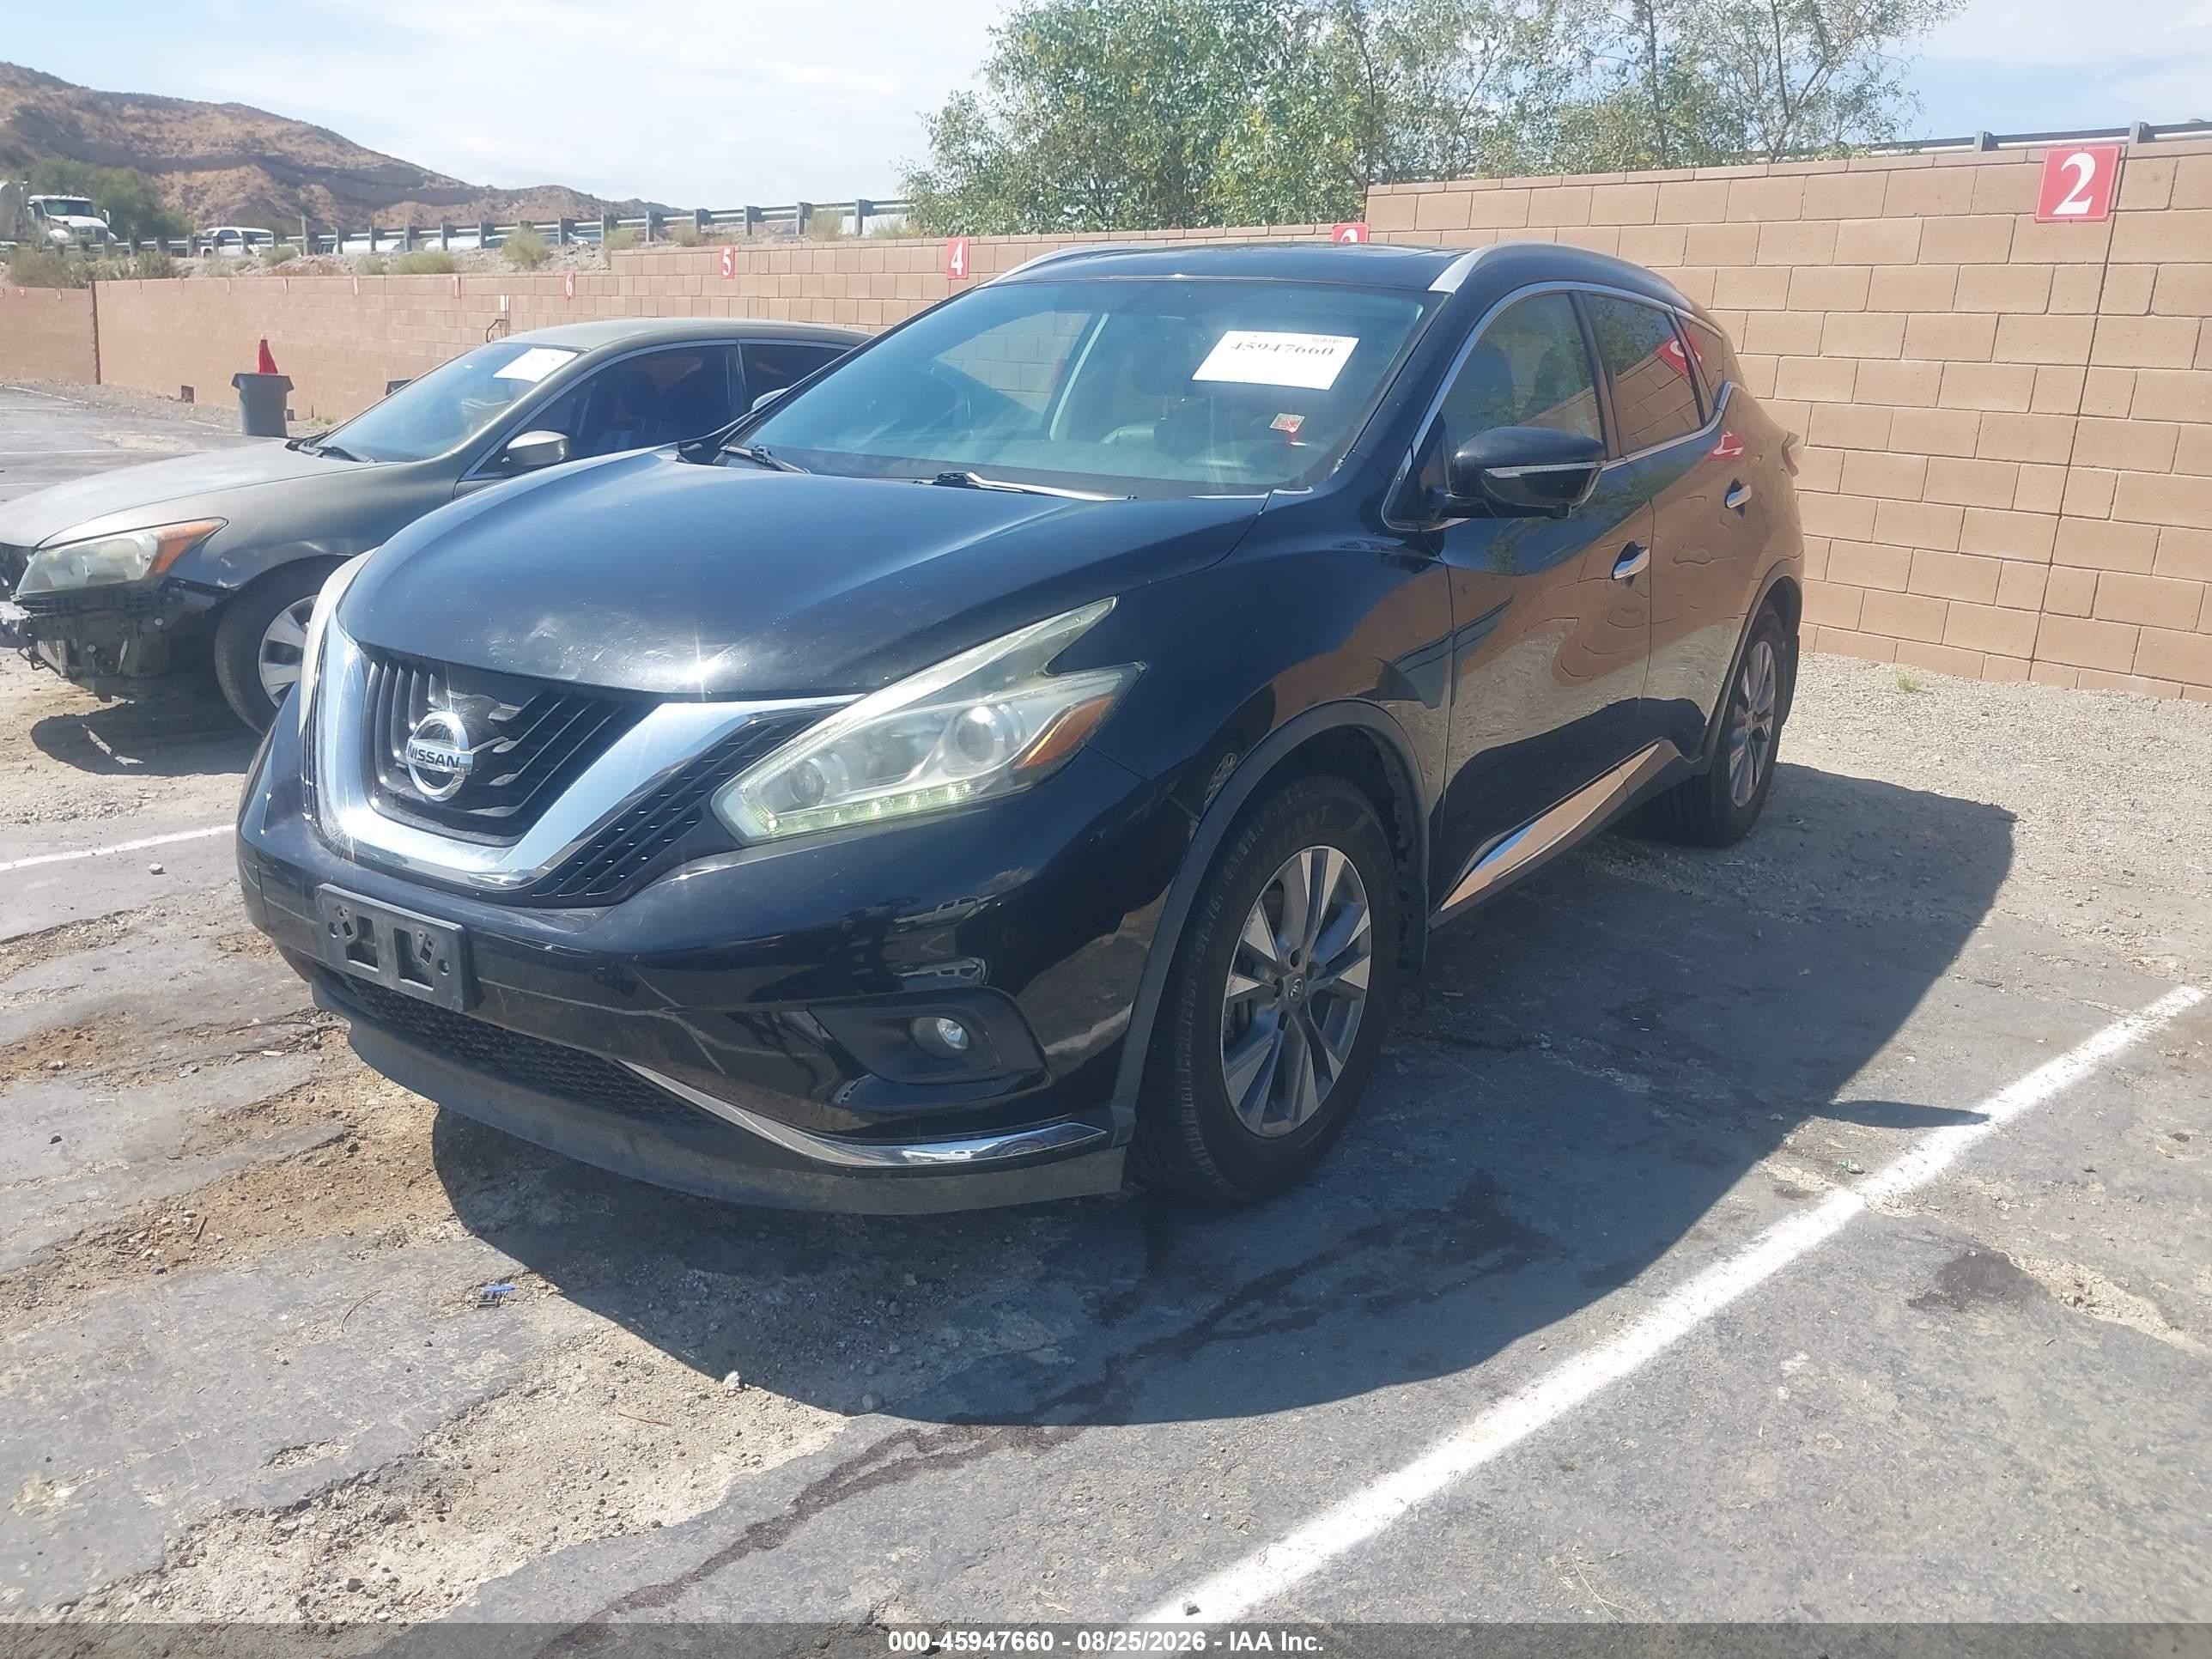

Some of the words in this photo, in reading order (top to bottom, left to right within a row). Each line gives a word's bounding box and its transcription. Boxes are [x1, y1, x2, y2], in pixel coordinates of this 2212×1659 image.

[2052, 152, 2096, 215] 2
[722, 247, 732, 276] 5
[950, 240, 964, 276] 4
[565, 272, 573, 297] 6
[407, 745, 460, 769] NISSAN
